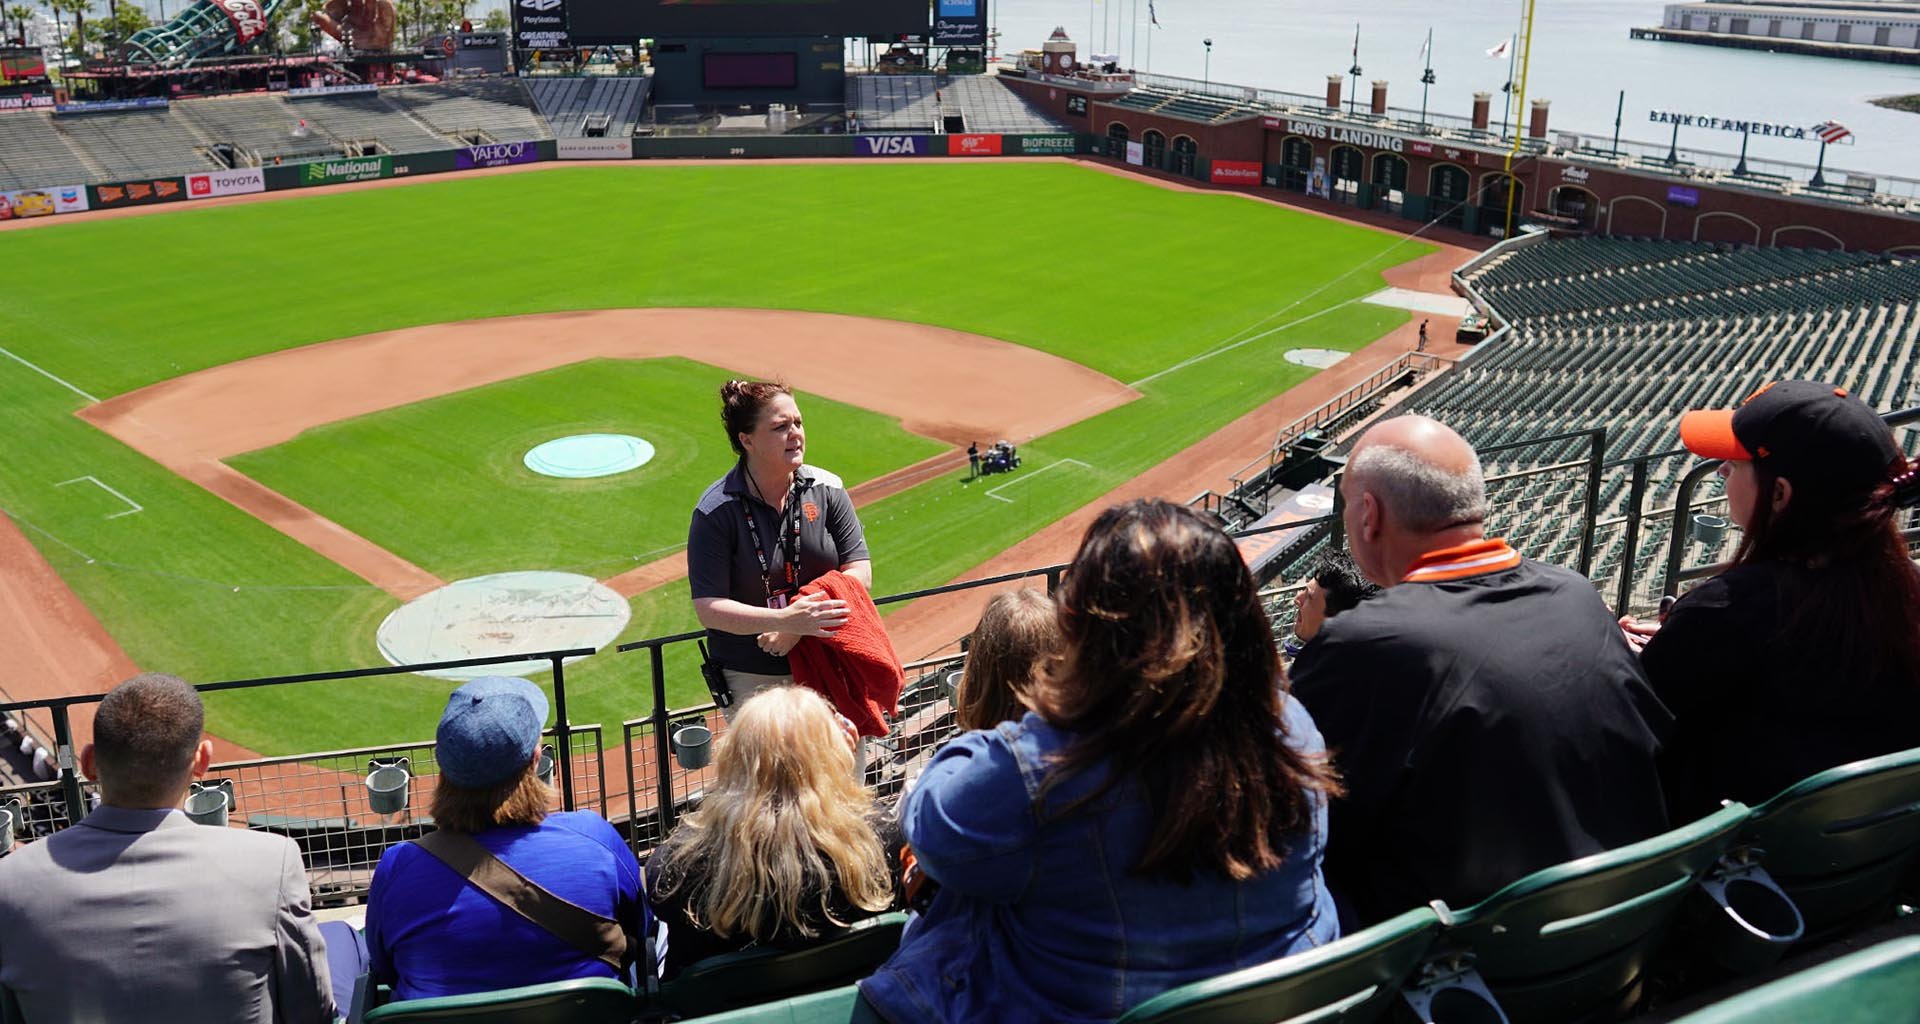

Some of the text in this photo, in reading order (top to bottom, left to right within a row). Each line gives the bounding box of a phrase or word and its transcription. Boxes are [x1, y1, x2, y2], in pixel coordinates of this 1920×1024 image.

[523, 16, 561, 24] PlayStation
[520, 31, 568, 40] GREATNESS
[1649, 110, 1806, 140] BANK OF AMERICA
[865, 137, 915, 154] VISA
[1330, 126, 1403, 153] LANDING
[469, 142, 524, 163] YAHOO!
[326, 158, 382, 176] National
[215, 175, 261, 188] TOYOTA
